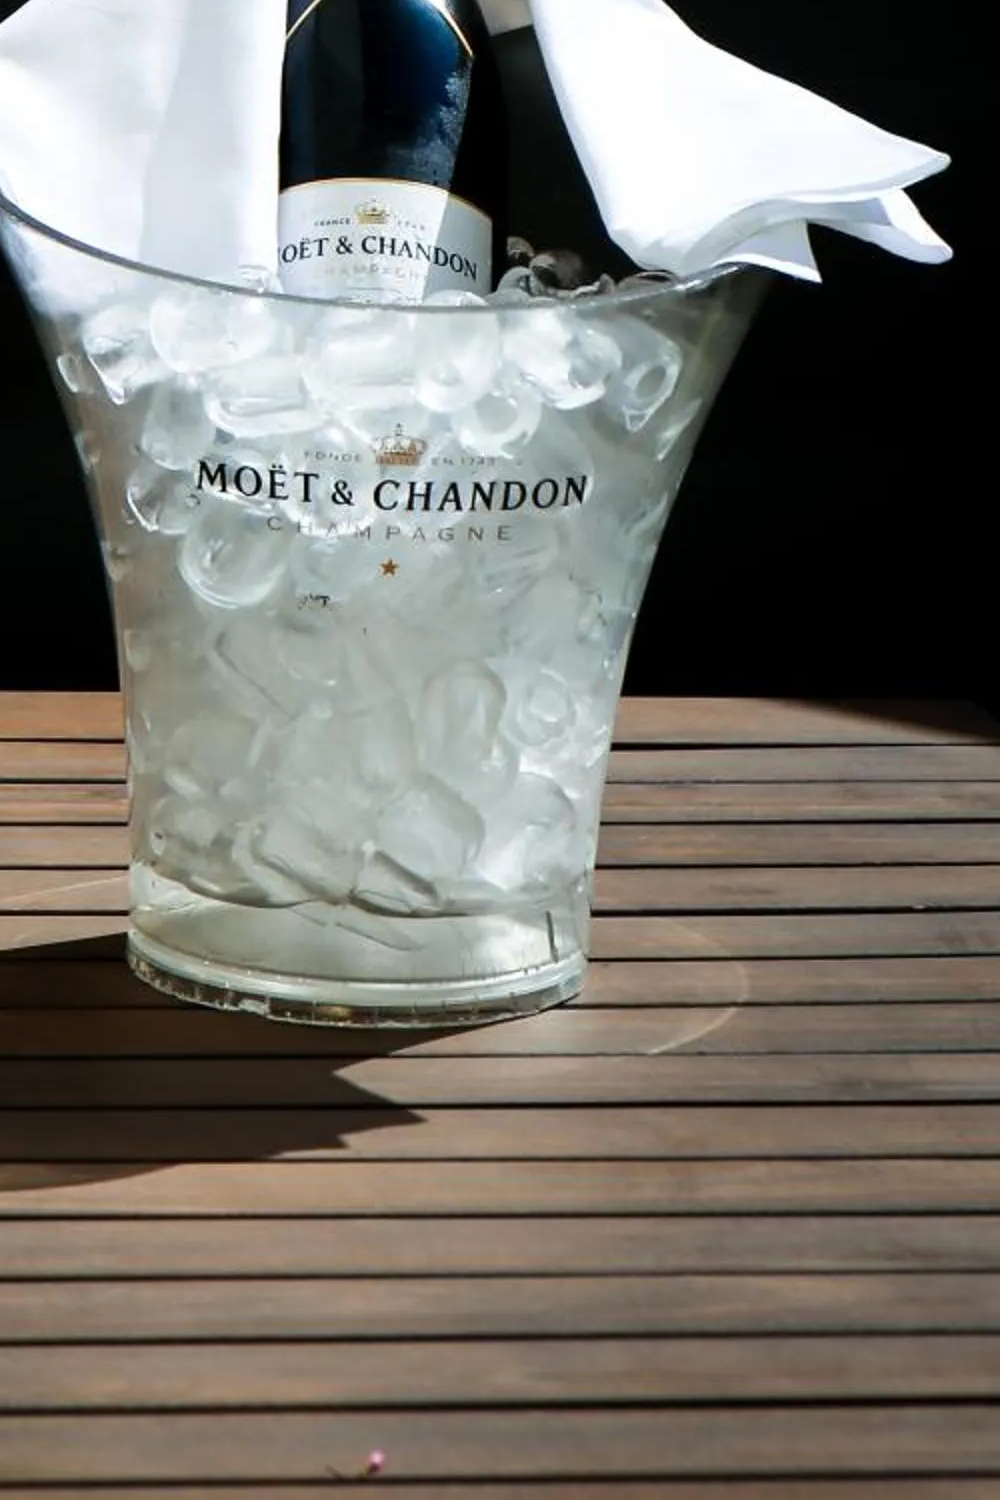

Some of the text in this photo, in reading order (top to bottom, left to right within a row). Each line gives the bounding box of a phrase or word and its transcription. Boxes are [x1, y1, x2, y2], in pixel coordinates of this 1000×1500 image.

[277, 236, 329, 264] OËT
[335, 235, 354, 255] &
[361, 235, 479, 284] CHANDON
[196, 459, 588, 512] MOËT & CHANDON
[266, 515, 514, 542] CHAMPAGNE
